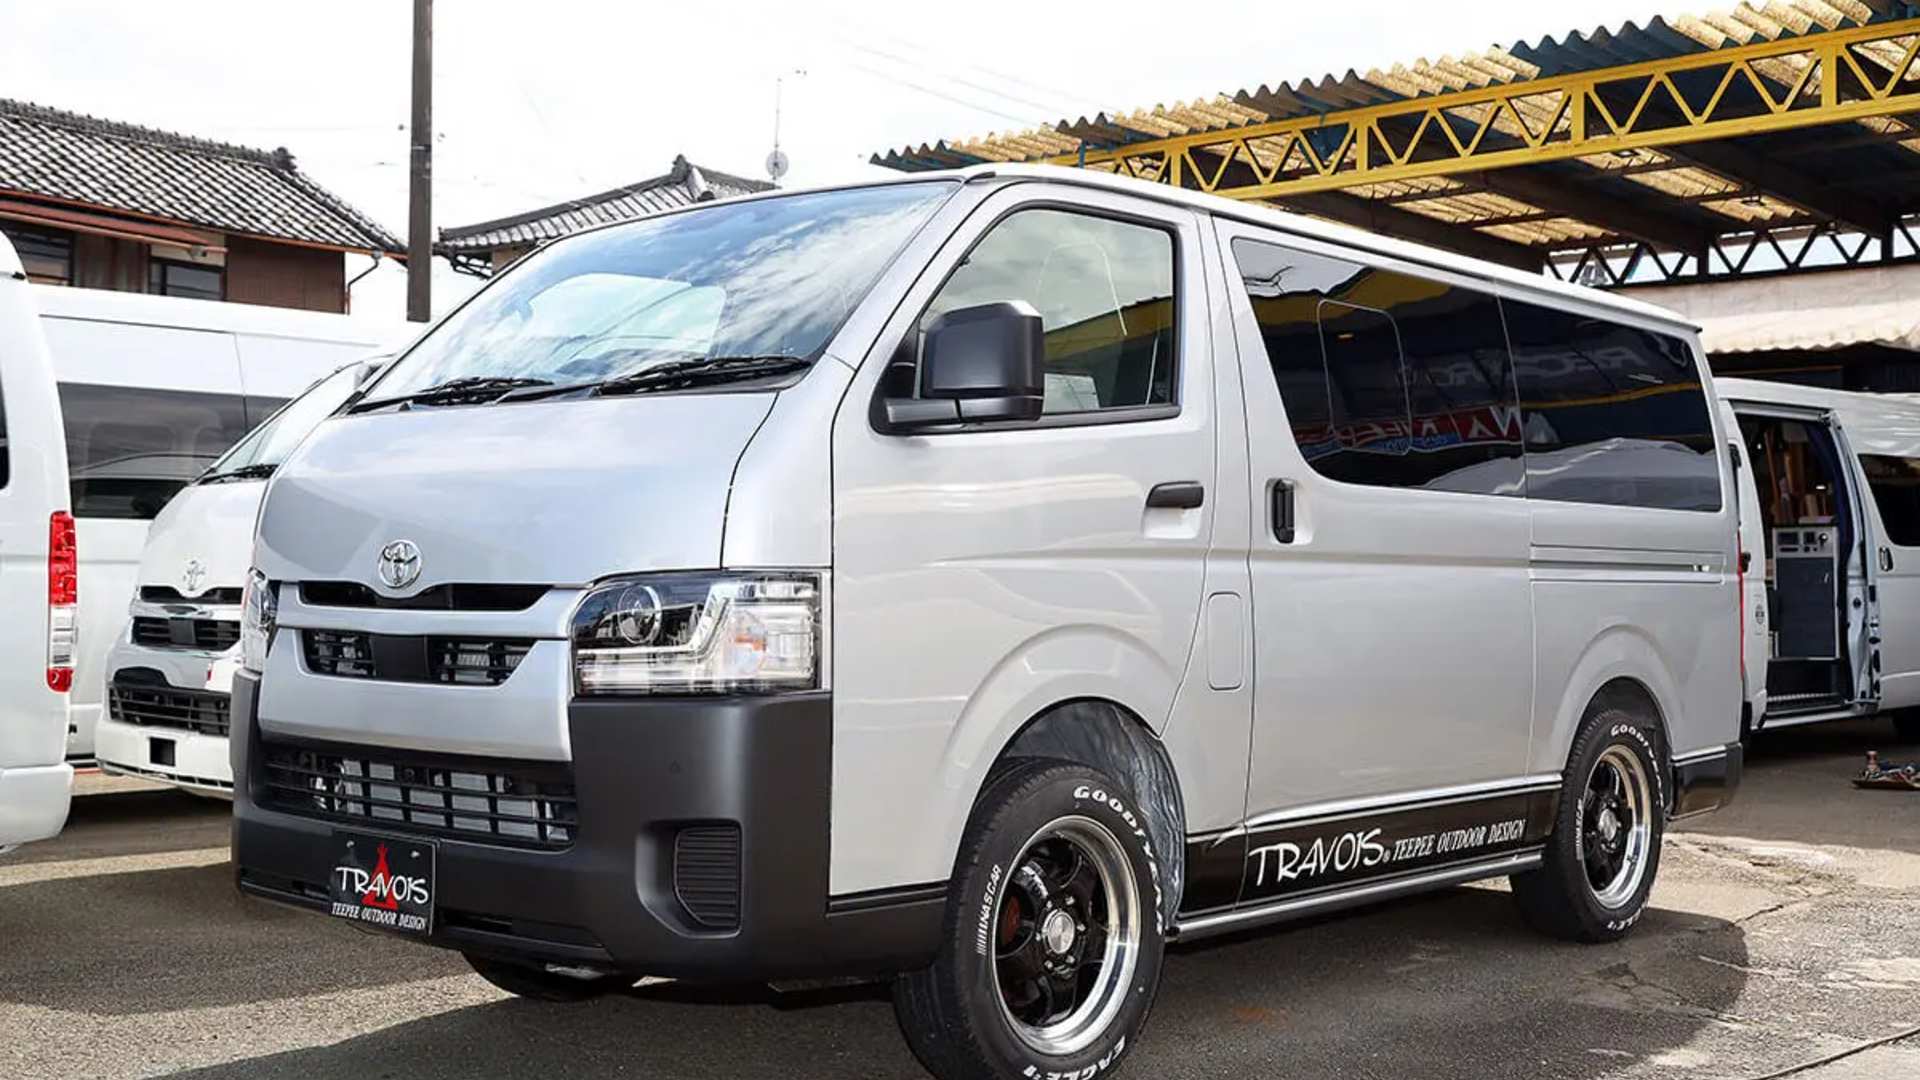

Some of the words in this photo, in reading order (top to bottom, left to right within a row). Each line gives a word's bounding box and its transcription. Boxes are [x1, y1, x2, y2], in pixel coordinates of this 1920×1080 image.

[1393, 834, 1435, 861] TEEPEE
[1436, 826, 1487, 853] OUTDOOR
[1487, 819, 1526, 844] DESIGN
[361, 907, 397, 925] OUTDOOR
